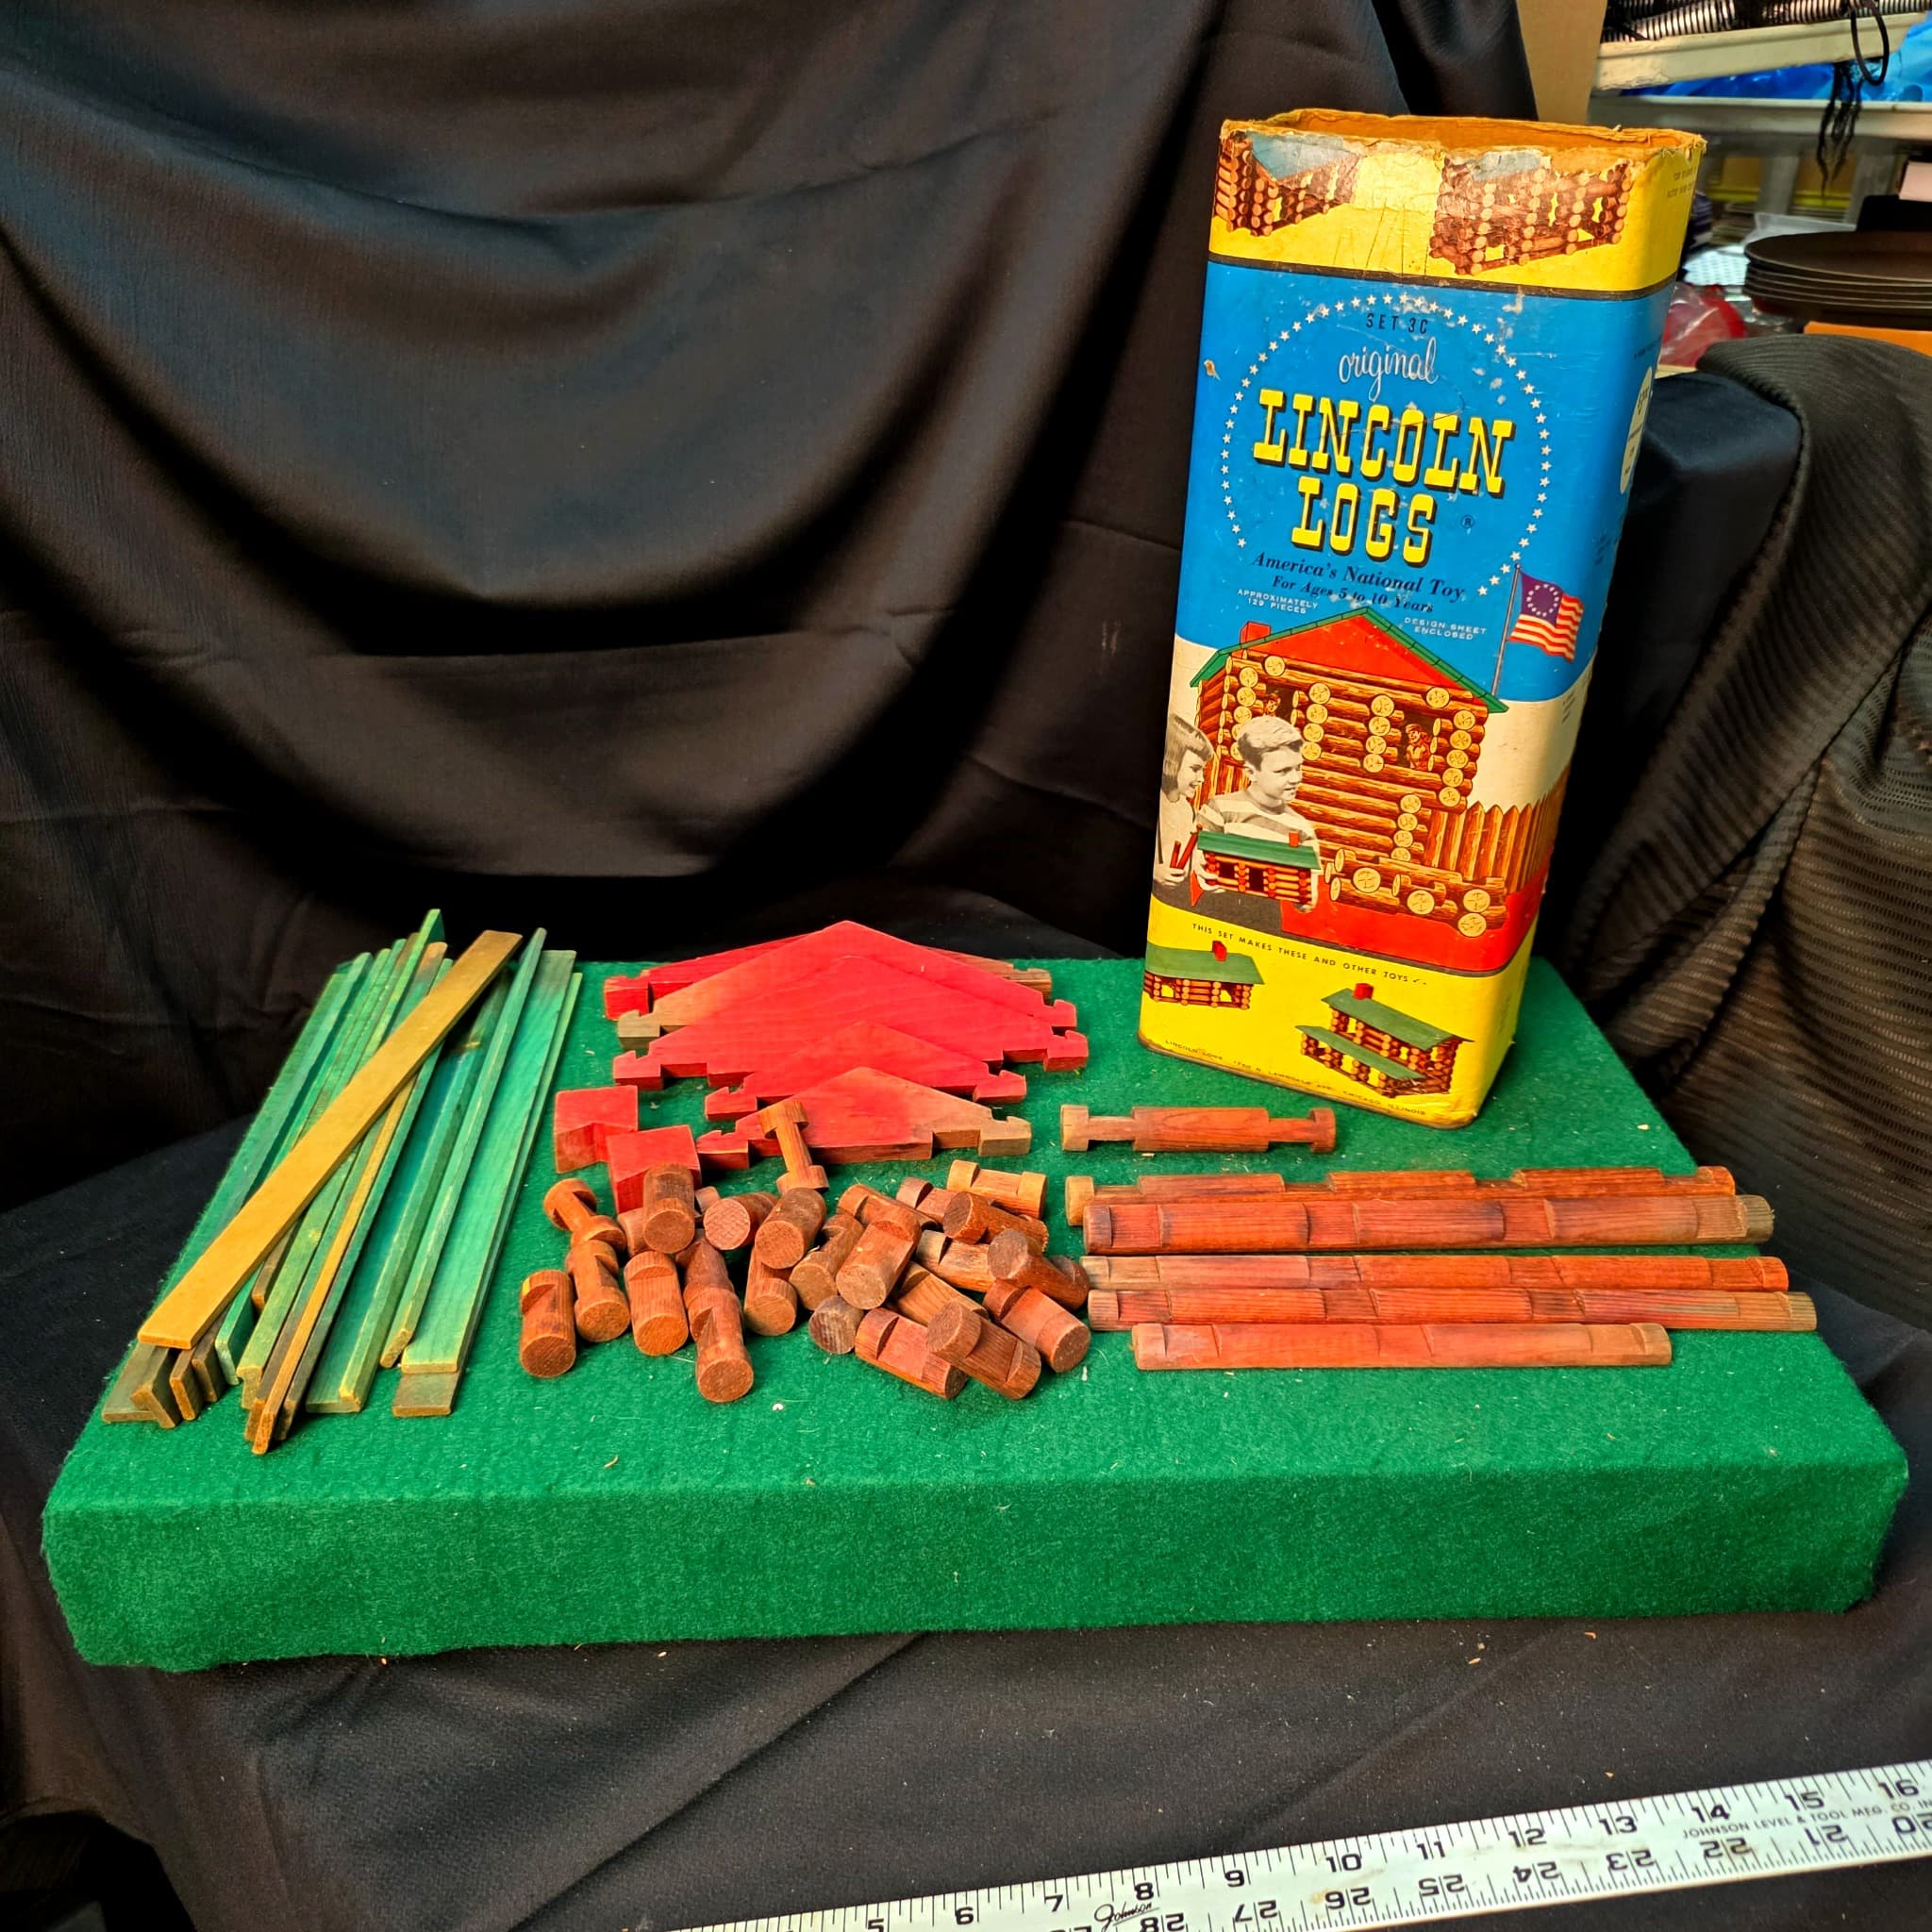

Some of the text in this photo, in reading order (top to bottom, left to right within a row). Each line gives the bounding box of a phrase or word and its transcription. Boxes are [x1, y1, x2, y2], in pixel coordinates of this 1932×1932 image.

[1366, 312, 1428, 335] SET 3C
[1339, 337, 1438, 402] original
[1252, 388, 1515, 497] LINCOLN
[1291, 475, 1437, 566] LOGS
[1252, 551, 1465, 603] America's National Toy
[1272, 575, 1434, 613] For Ages 5 to 10 Years
[1237, 589, 1319, 609] APPROXIMATELY
[1270, 602, 1307, 614] PIECES
[1404, 616, 1488, 635] DESIGN SHEET
[1414, 626, 1474, 641] ENCLOSED
[1191, 924, 1408, 983] THIS SET MAKES THESE AND OTHER TOYS
[1683, 1822, 1750, 1839] JOHNSON
[1754, 1817, 1791, 1829] LEVEL
[1811, 1809, 1848, 1822] TOOL
[956, 1907, 974, 1925] 6
[1045, 1894, 1063, 1912] 7
[1135, 1882, 1154, 1901] 8
[1224, 1870, 1244, 1887] 9
[1325, 1854, 1362, 1873] 10
[1417, 1841, 1445, 1859] 11
[1508, 1828, 1546, 1847] 12
[1599, 1816, 1637, 1835] 13
[1691, 1804, 1730, 1823] 14
[1785, 1791, 1824, 1811] 15
[1878, 1779, 1919, 1799] 16
